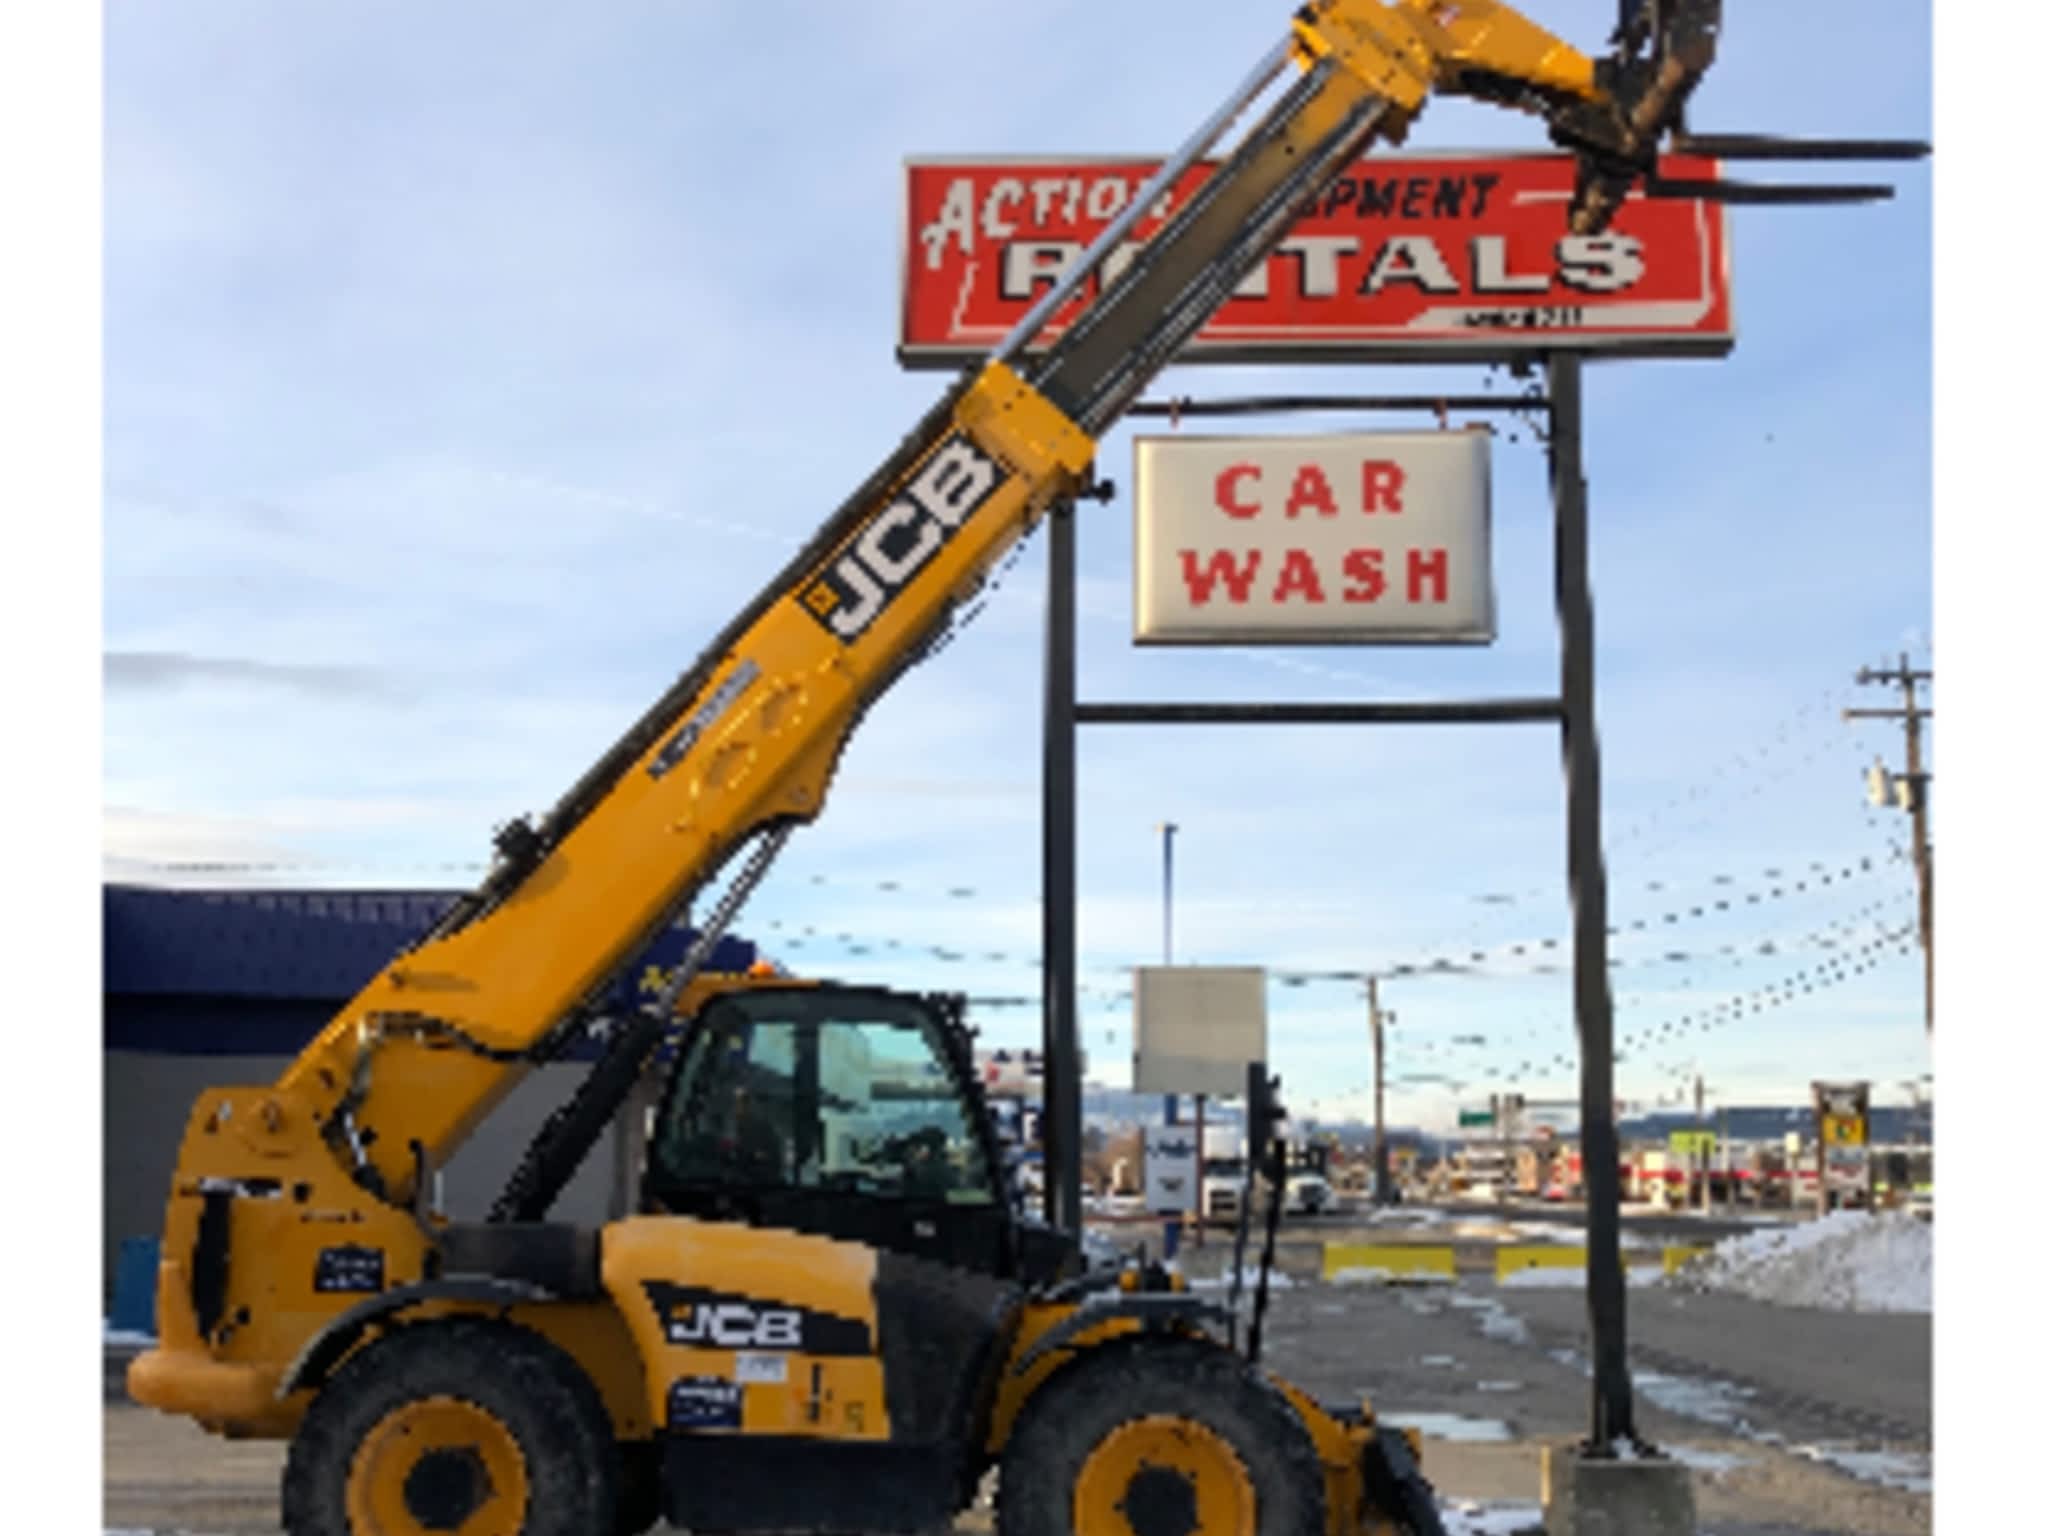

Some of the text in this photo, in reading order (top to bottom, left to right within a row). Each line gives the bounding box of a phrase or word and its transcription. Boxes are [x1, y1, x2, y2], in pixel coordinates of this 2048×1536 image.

[1299, 173, 1499, 219] PMENT
[1000, 231, 1645, 299] RTALS
[1214, 459, 1406, 519] CAR
[830, 438, 996, 637] JCB
[1178, 547, 1449, 606] WASH
[670, 1303, 802, 1345] JCB
